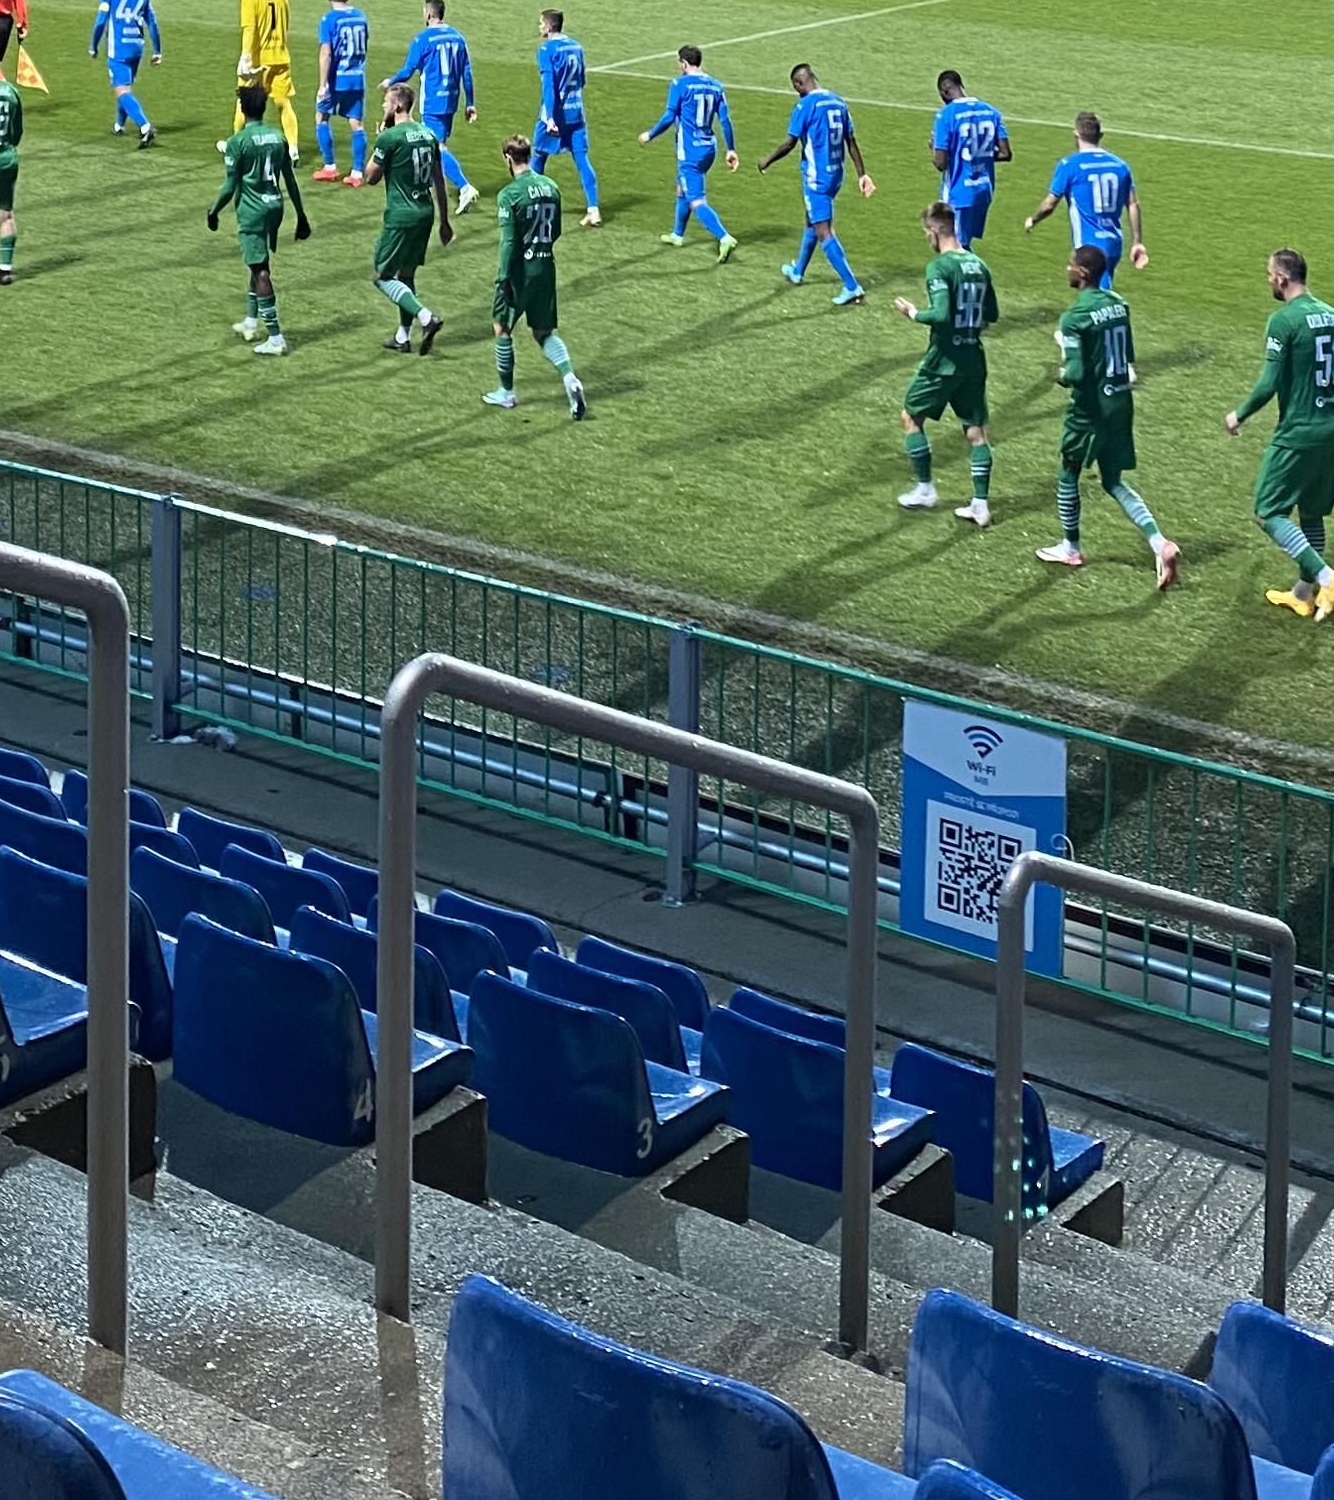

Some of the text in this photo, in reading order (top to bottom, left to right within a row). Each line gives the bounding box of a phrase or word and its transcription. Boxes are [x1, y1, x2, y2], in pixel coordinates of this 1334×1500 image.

[267, 2, 277, 30] 1
[567, 54, 580, 87] 2
[827, 109, 844, 145] 5
[411, 147, 433, 187] 18
[1088, 173, 1119, 213] 10
[1103, 325, 1128, 379] 10
[966, 759, 997, 777] Wi-Fi
[636, 1116, 654, 1160] 3
